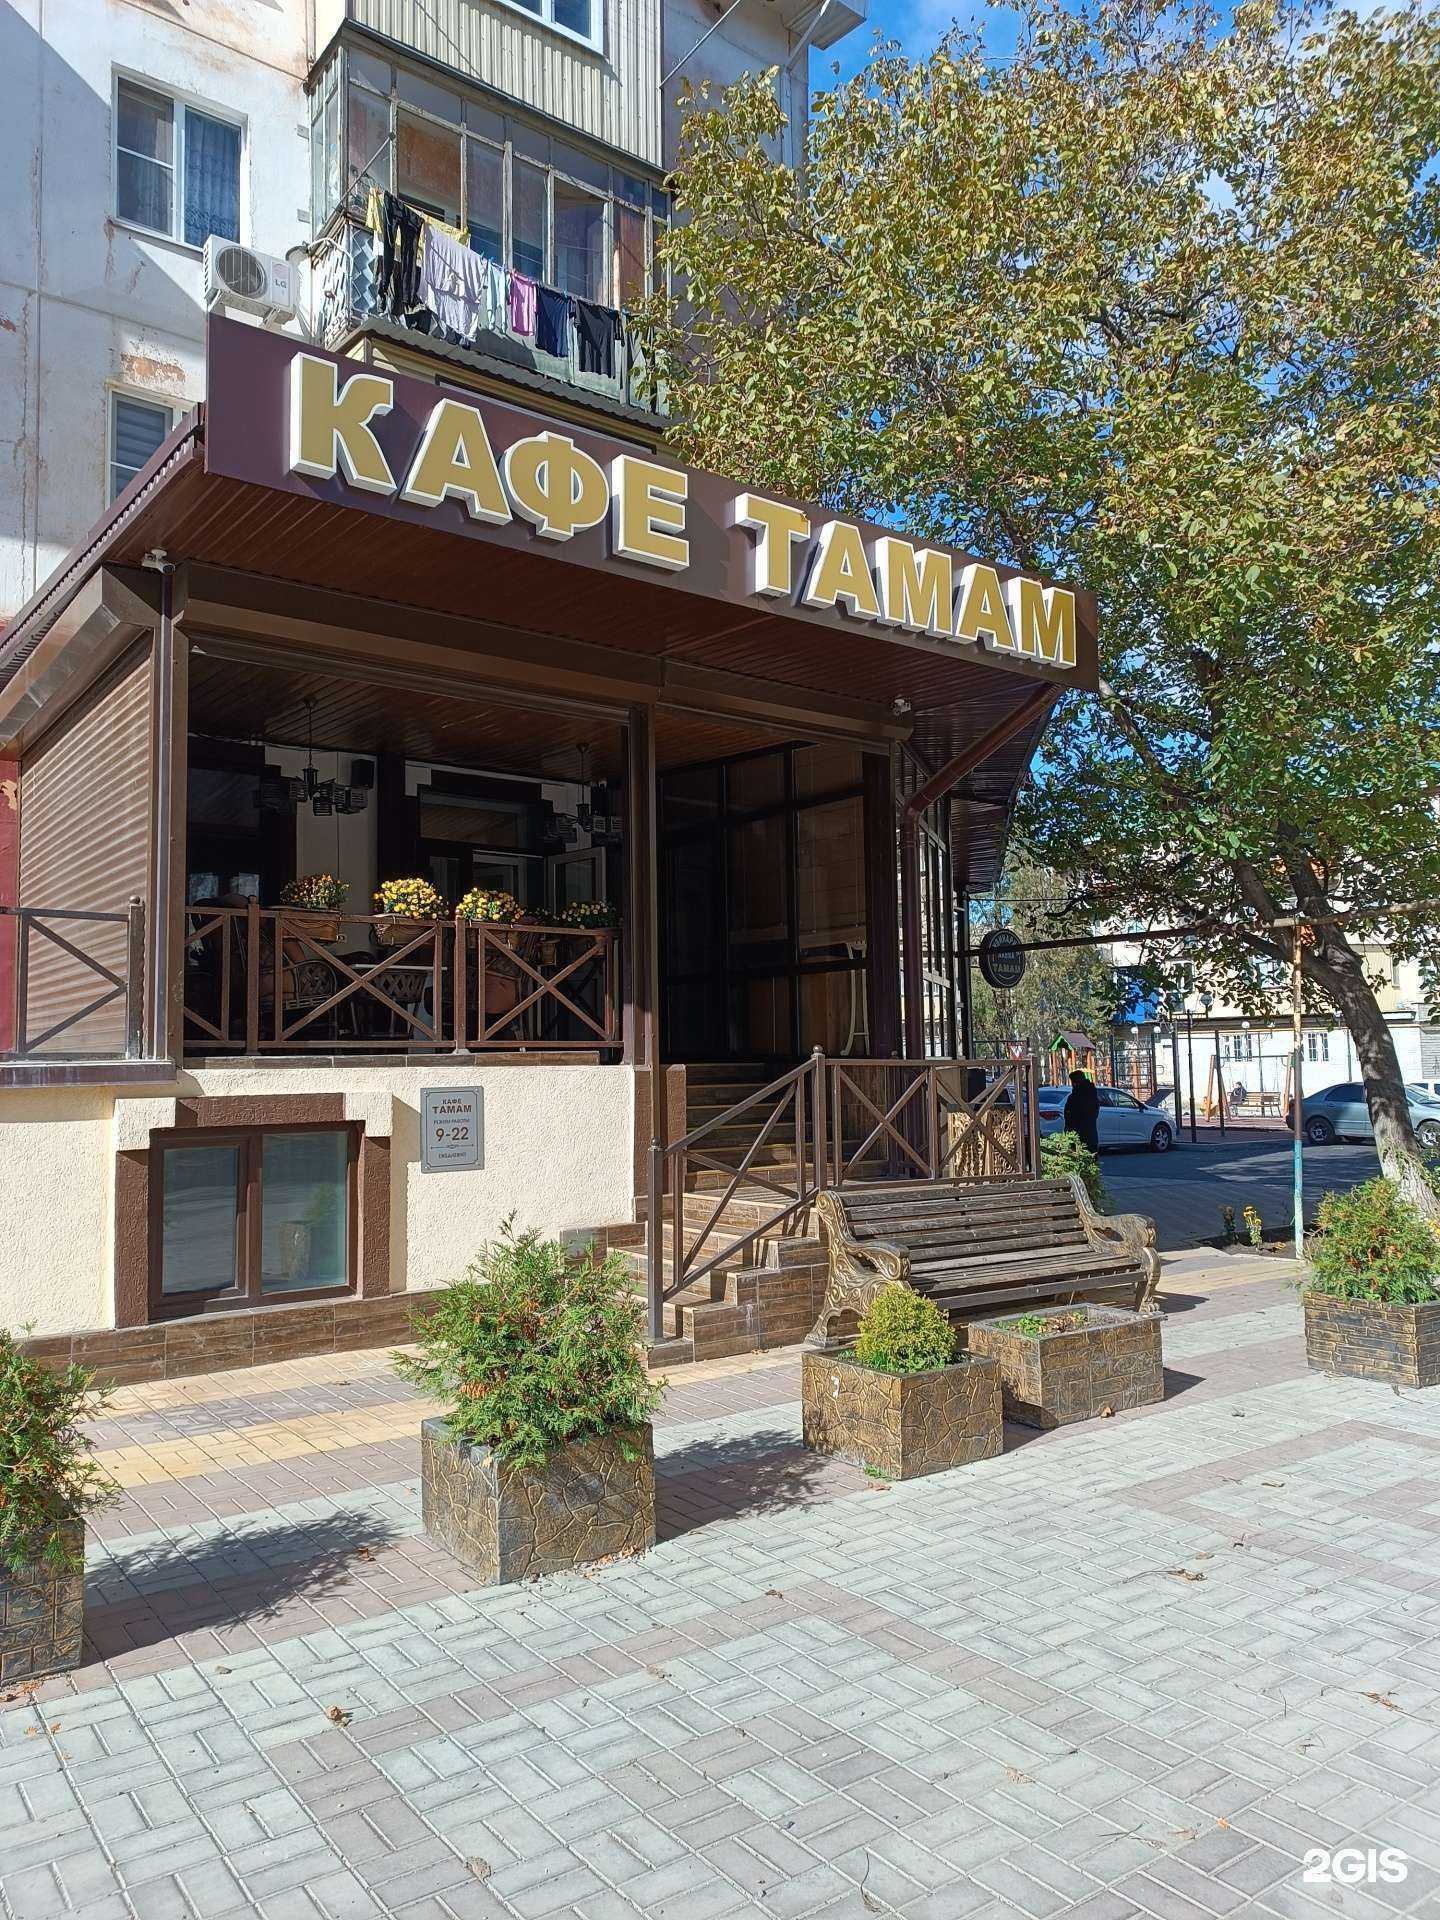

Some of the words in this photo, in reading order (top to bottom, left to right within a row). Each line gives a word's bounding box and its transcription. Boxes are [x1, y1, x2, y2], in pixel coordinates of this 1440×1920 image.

[275, 279, 287, 289] LG
[290, 352, 690, 571] КАФЕ
[734, 492, 1076, 670] ТАМАМ
[432, 1104, 472, 1114] ТАМАМ
[435, 1126, 469, 1142] 9-22
